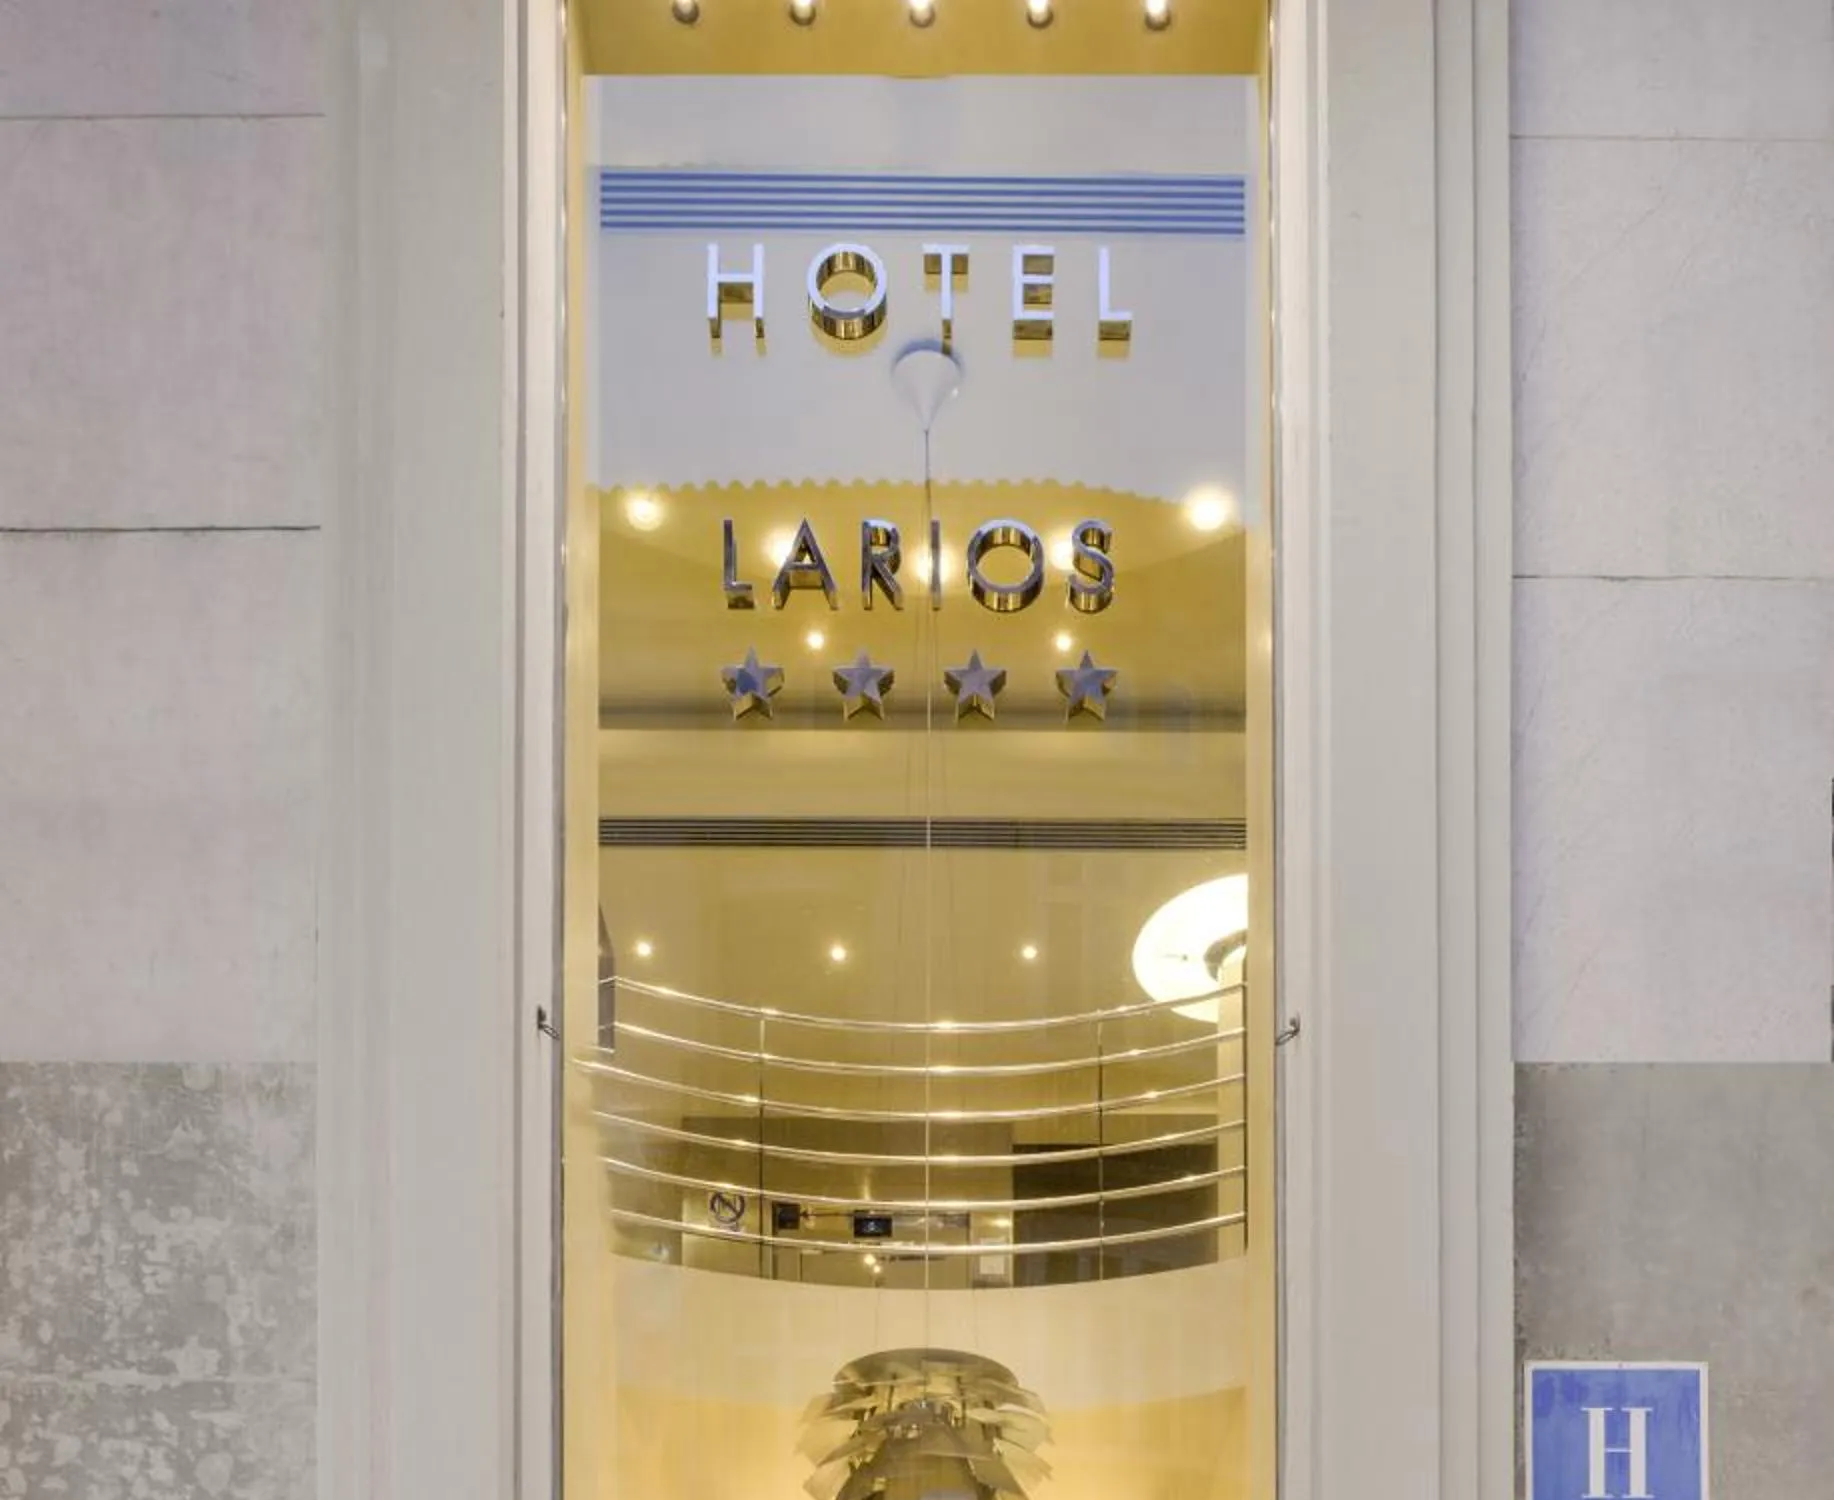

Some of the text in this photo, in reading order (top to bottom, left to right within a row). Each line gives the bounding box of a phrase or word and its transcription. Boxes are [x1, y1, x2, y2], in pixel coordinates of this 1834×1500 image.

[707, 242, 1133, 340] HOTEL
[723, 518, 1115, 611] LARIOS
[1581, 1406, 1654, 1499] H
